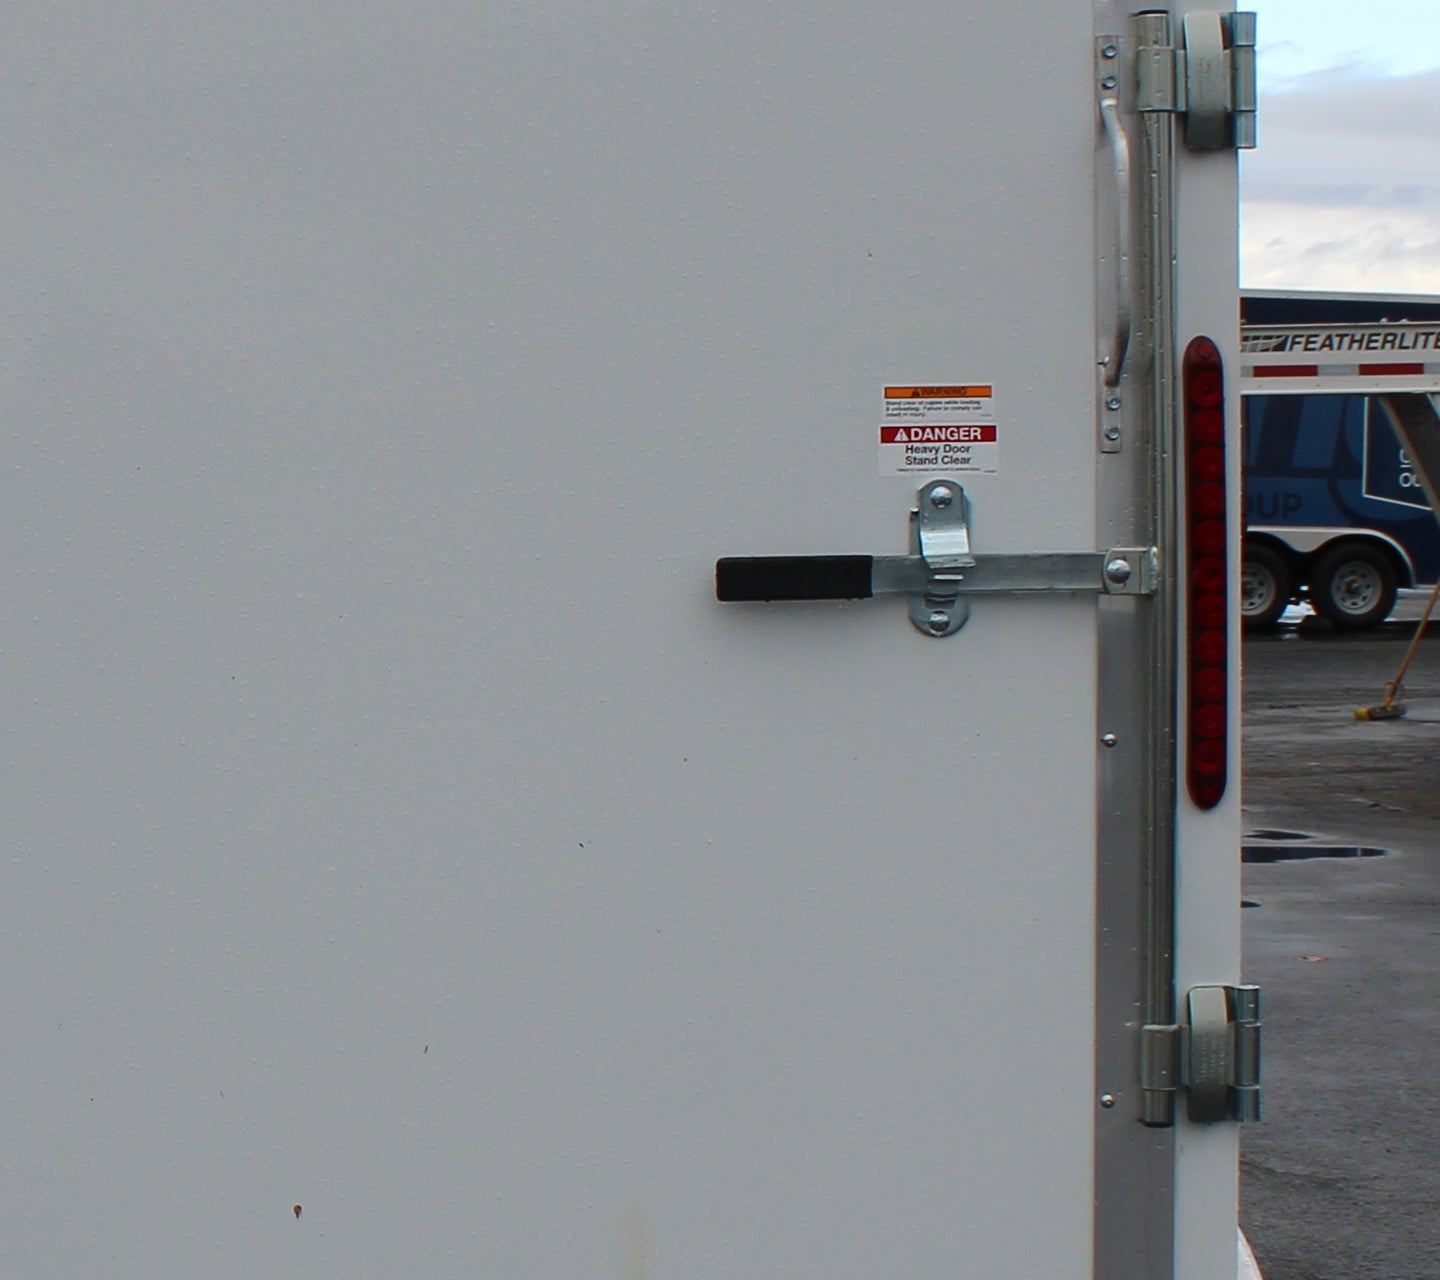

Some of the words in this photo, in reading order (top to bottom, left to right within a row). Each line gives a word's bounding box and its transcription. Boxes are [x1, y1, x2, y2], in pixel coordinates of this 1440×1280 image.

[920, 387, 967, 397] WARNING
[910, 427, 982, 441] DANGER
[905, 445, 940, 455] Heavy
[943, 444, 971, 454] Door
[905, 456, 938, 465] Stand
[941, 455, 971, 465] Clear
